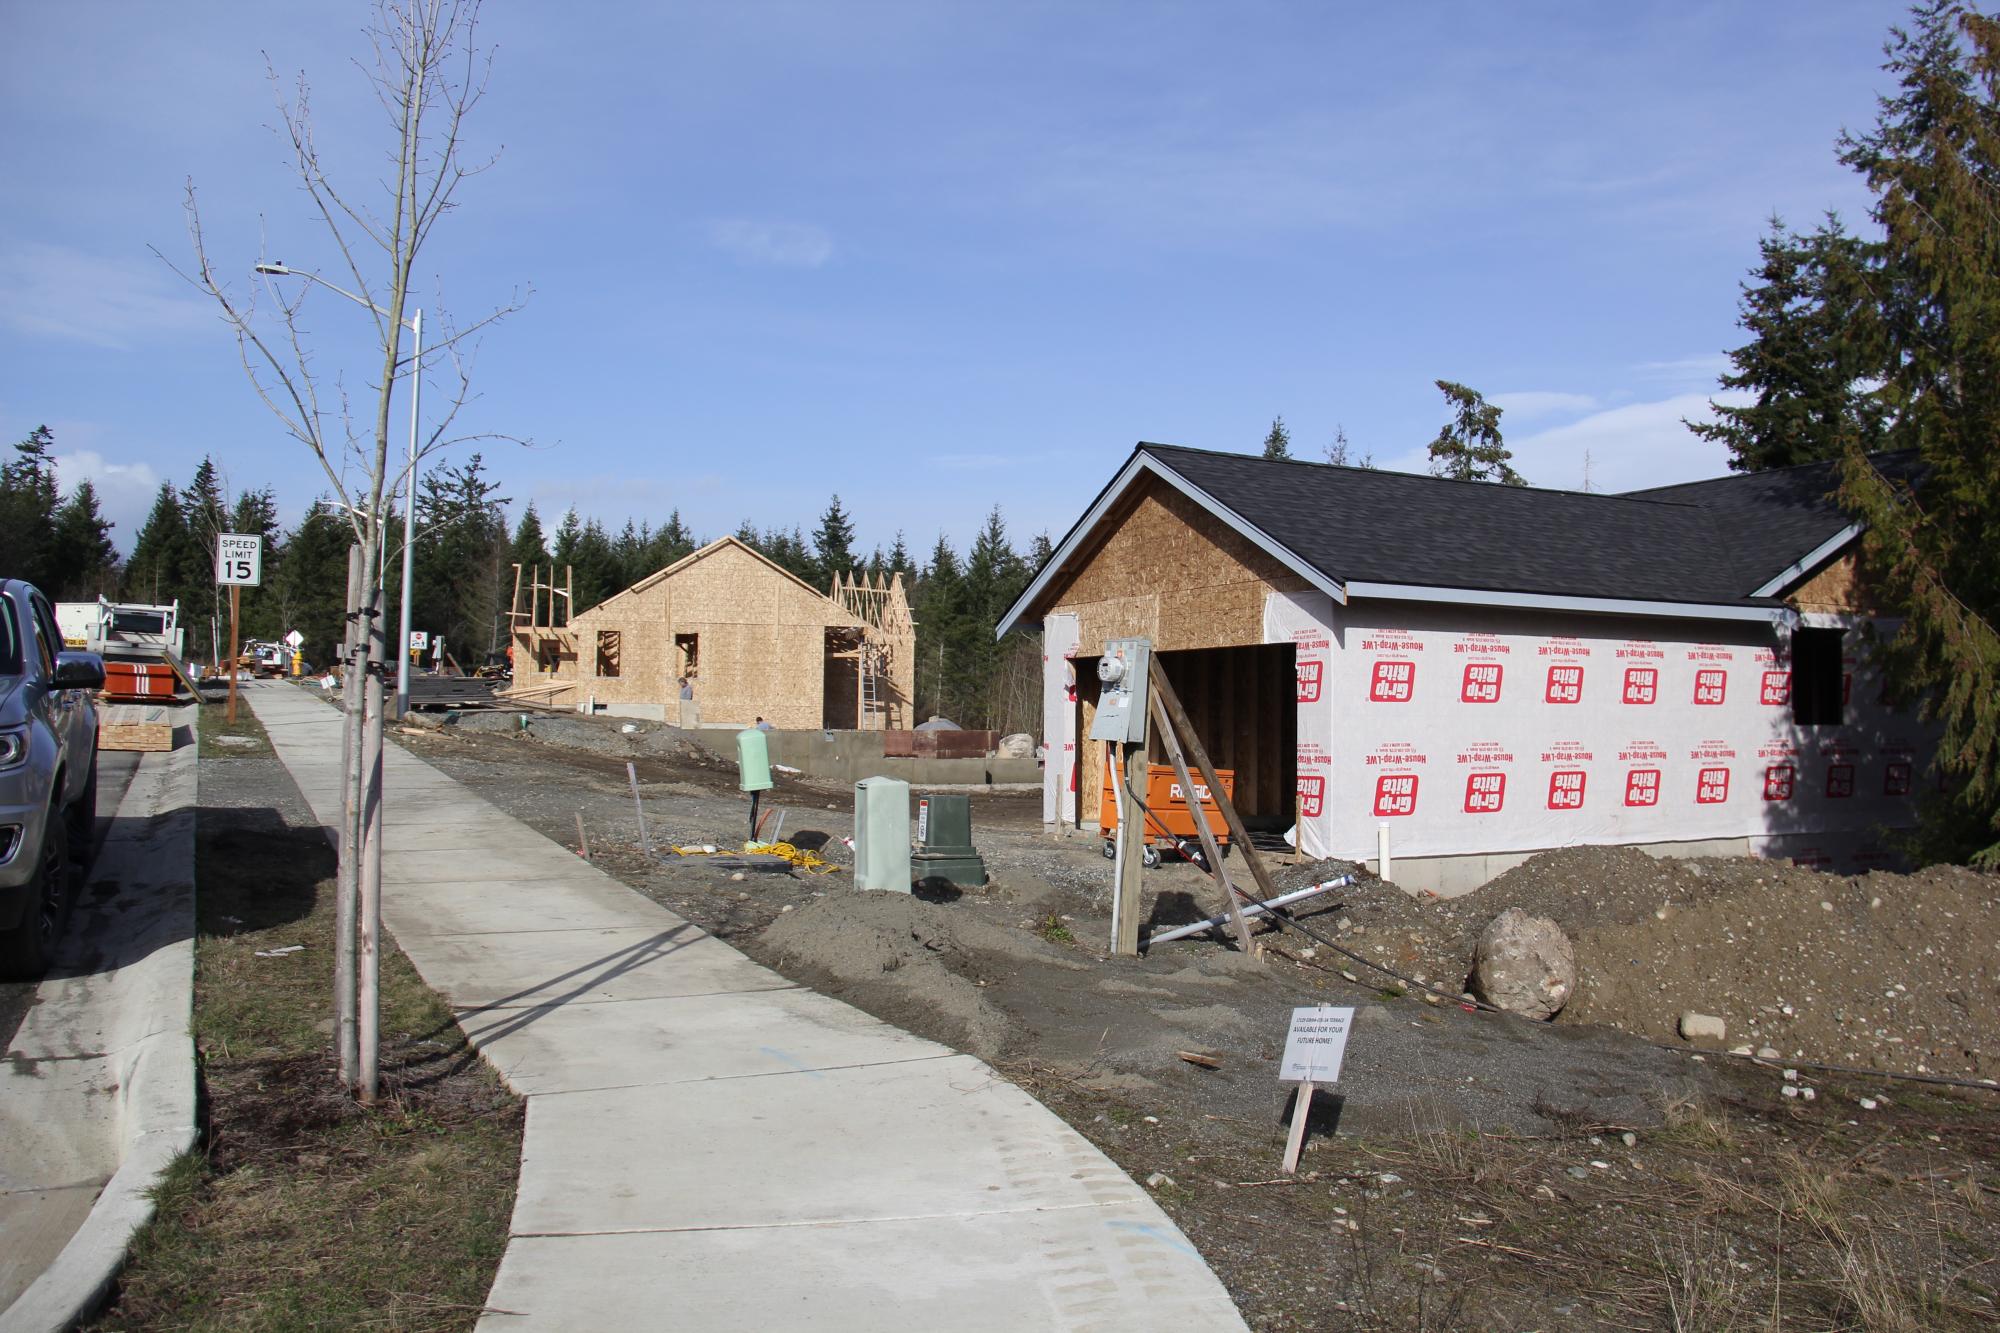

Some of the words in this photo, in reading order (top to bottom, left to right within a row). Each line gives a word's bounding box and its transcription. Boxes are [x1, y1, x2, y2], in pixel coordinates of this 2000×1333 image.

[222, 540, 257, 549] SPEED
[225, 550, 252, 559] LIMIT
[225, 560, 252, 579] 15
[1362, 640, 1424, 651] House-Wrap-LWE
[1455, 643, 1511, 653] House-Wrap-LWE
[1538, 646, 1591, 656] House-Wrap-LWE
[1379, 665, 1410, 681] Rite
[1469, 667, 1498, 682] Rite
[1553, 670, 1579, 684] Rite
[1629, 672, 1654, 686] Rite
[1701, 673, 1723, 687] Rite
[1376, 680, 1408, 699] Grip
[1466, 682, 1496, 700] Grip
[1550, 684, 1578, 701] Grip
[1627, 685, 1652, 702] Grip
[1698, 687, 1722, 702] Grip
[1366, 754, 1427, 764] House-Wrap-LWE
[1456, 753, 1515, 763] House-Wrap-LWE
[1540, 752, 1594, 761] House-Wrap-LWE
[1472, 777, 1501, 792] Rite
[1555, 775, 1581, 790] Rite
[1631, 773, 1657, 787] Rite
[1703, 771, 1726, 785] Rite
[1170, 784, 1212, 799] RIGID
[1297, 779, 1320, 795] Rite
[1382, 778, 1413, 794] Rite
[1700, 785, 1725, 801] Grip
[1379, 794, 1412, 812] Grip
[1469, 792, 1499, 810] Grip
[1552, 789, 1580, 807] Grip
[1629, 787, 1655, 804] Grip
[1315, 1037, 1333, 1045] HOME!
